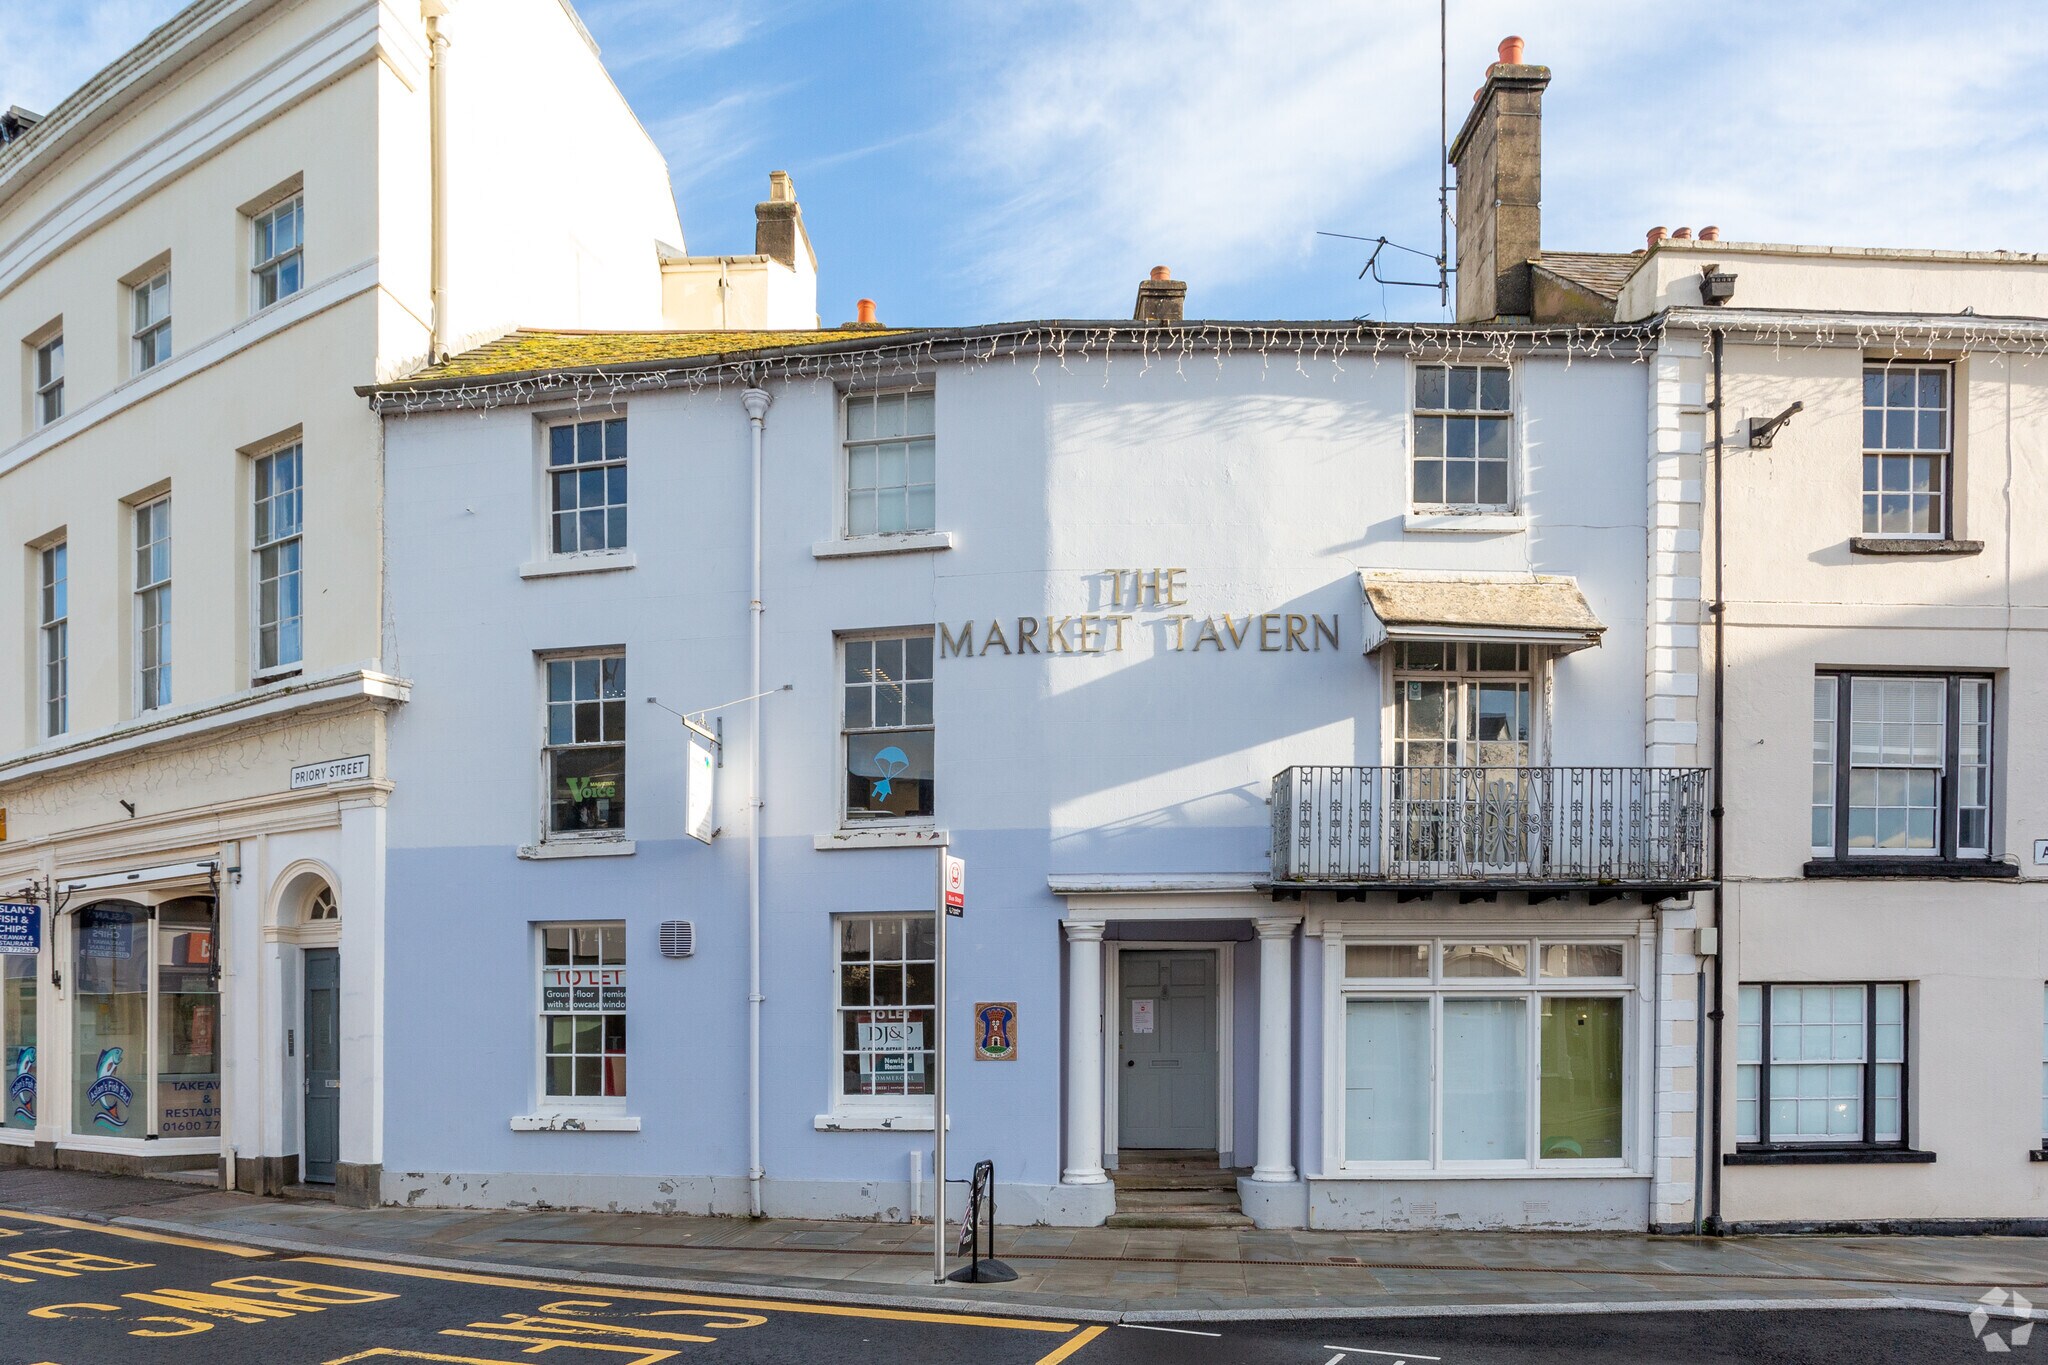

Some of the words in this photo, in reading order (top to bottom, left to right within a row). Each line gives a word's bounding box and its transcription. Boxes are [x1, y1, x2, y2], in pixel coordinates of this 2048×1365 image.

[1104, 567, 1188, 606] THE
[938, 614, 1133, 659] MARKET
[1167, 613, 1340, 652] TAVERN
[295, 767, 326, 784] PRIORY
[329, 761, 364, 778] STREET
[566, 777, 616, 802] Voice
[0, 905, 35, 915] SLAN'S
[21, 916, 29, 924] &
[0, 925, 28, 934] CHIPS
[556, 970, 582, 985] TO
[589, 970, 620, 985] LET
[90, 1083, 108, 1100] Aslan's
[108, 1080, 119, 1092] Fish
[119, 1086, 129, 1101] Bar
[203, 1095, 211, 1103] &
[165, 1108, 220, 1118] RESTAUR
[163, 1122, 200, 1131] 01600
[205, 1121, 219, 1130] 77
